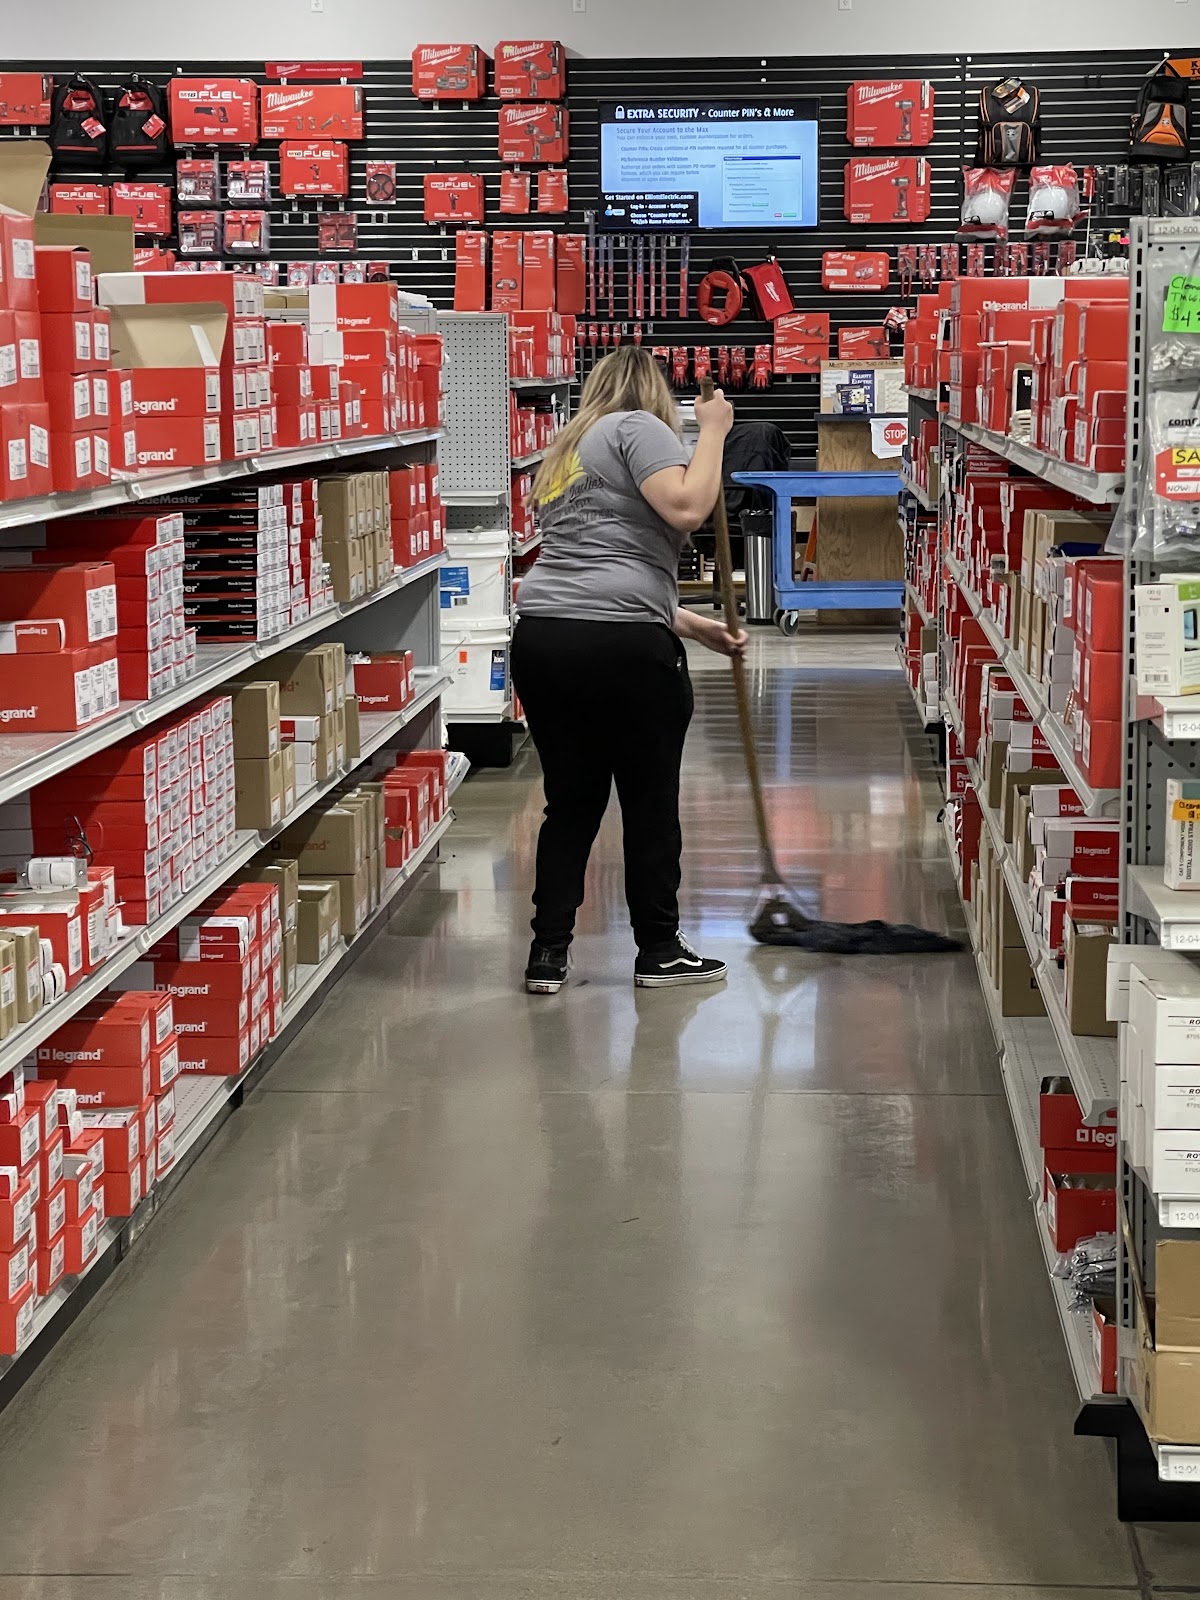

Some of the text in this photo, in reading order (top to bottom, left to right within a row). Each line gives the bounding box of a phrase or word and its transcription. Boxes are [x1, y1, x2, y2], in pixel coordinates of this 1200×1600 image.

[420, 46, 461, 62] Milwaukee
[502, 42, 544, 59] Milwaukee
[199, 91, 242, 99] FUEL
[267, 89, 314, 106] Milwaukee
[857, 82, 903, 101] Milwaukee
[504, 107, 547, 123] Milwaukee
[627, 109, 655, 119] EXTRA
[657, 108, 699, 118] SECURITY
[708, 108, 740, 117] Counter
[741, 108, 762, 117] PIN's
[773, 108, 794, 117] More
[854, 160, 899, 178] Milwaukee
[344, 317, 371, 326] legrand
[778, 315, 806, 326] Milwaukee
[843, 330, 870, 340] Milwaukee
[777, 345, 805, 355] Milwaukee
[349, 353, 370, 361] legrand
[134, 399, 176, 414] egrand
[884, 429, 907, 439] STOP
[138, 449, 174, 465] grand
[363, 695, 389, 704] legrand
[1083, 846, 1110, 857] legrand
[167, 984, 209, 997] legrand
[174, 1021, 206, 1035] grand
[52, 1048, 102, 1062] legrand
